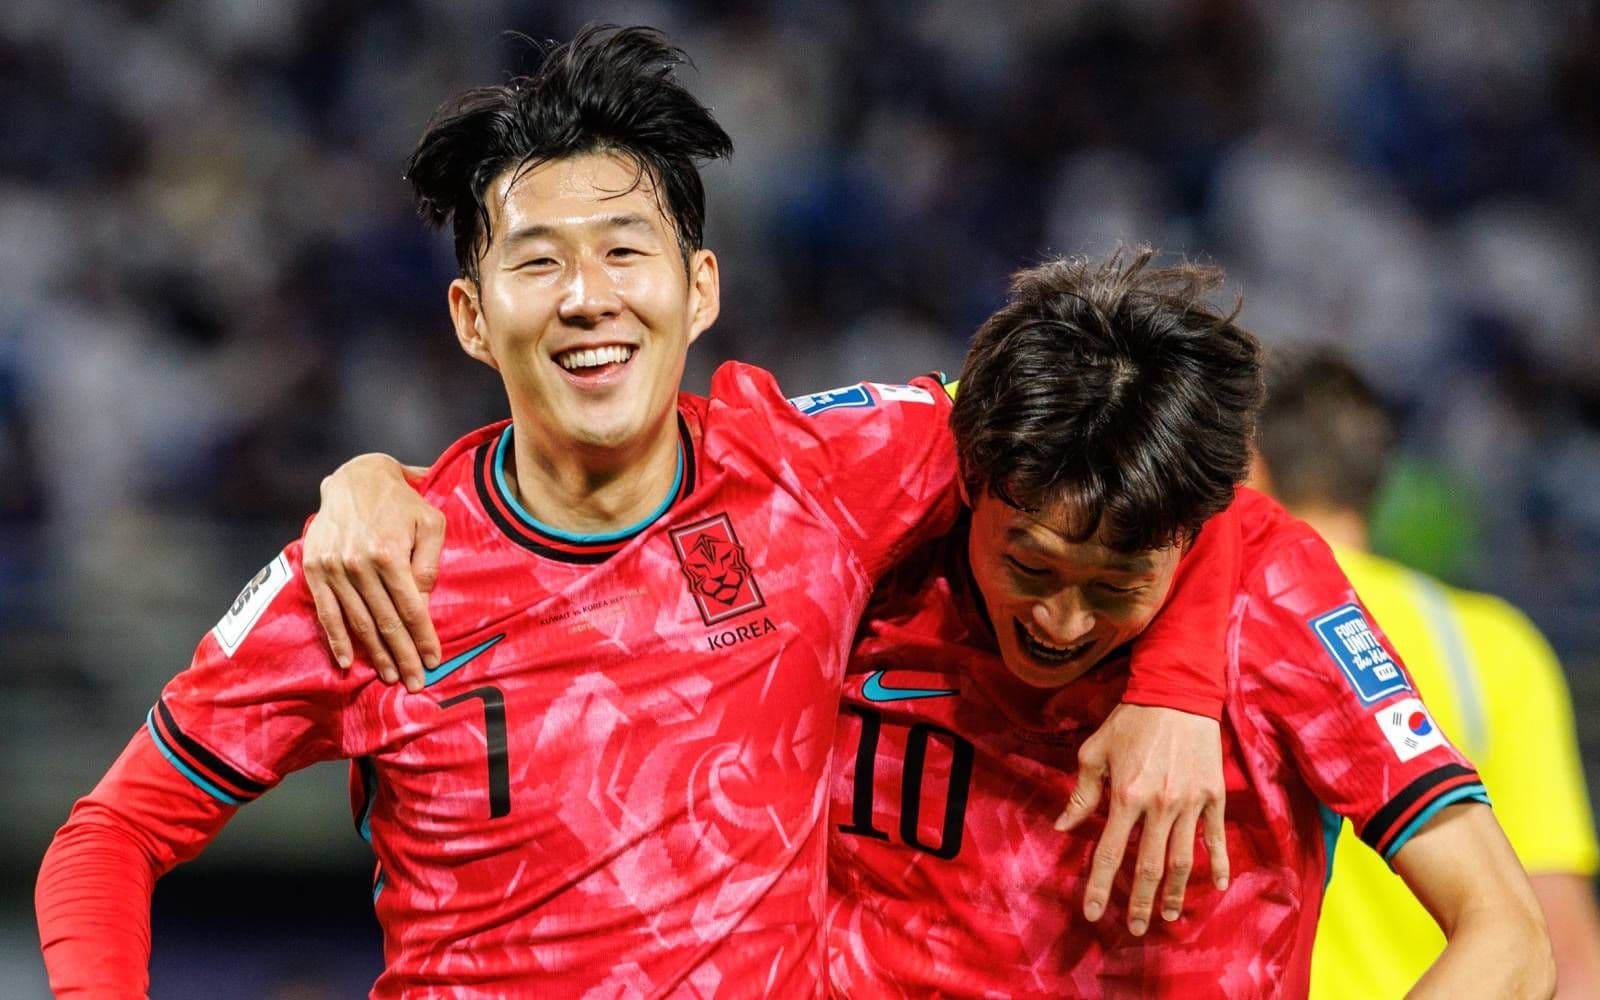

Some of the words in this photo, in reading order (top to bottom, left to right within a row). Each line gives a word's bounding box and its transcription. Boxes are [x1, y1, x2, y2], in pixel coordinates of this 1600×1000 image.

[541, 611, 570, 625] KUWAIT
[583, 601, 609, 614] KOREA
[707, 617, 777, 651] KOREA
[437, 685, 512, 820] 7
[836, 703, 976, 860] 10
